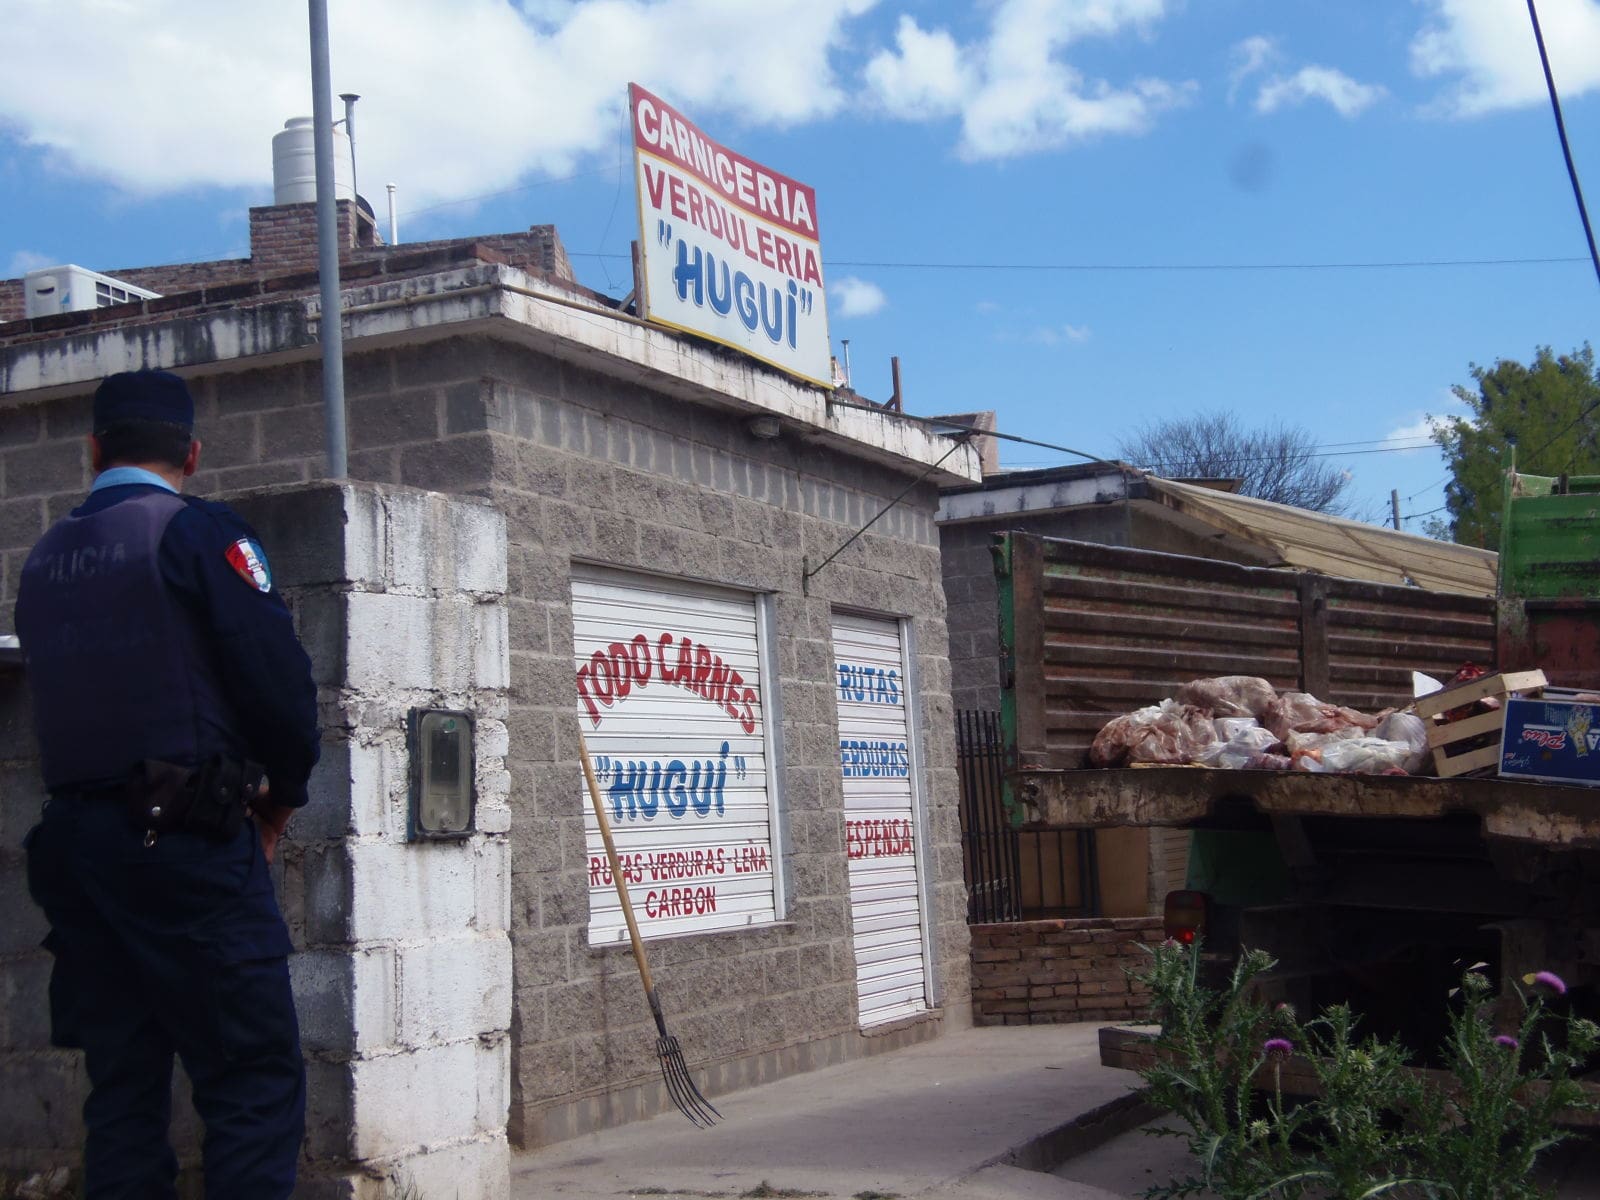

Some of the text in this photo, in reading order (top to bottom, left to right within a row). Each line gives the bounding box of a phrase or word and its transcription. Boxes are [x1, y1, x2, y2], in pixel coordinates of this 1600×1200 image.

[637, 99, 815, 232] CARNICERIA
[643, 163, 822, 288] VERDULERIA
[577, 633, 757, 735] TODO CARNES
[836, 664, 898, 704] RUTAS
[841, 741, 908, 777] ERDURAS
[847, 818, 911, 858] ESPENSA
[645, 886, 716, 918] CARBON
